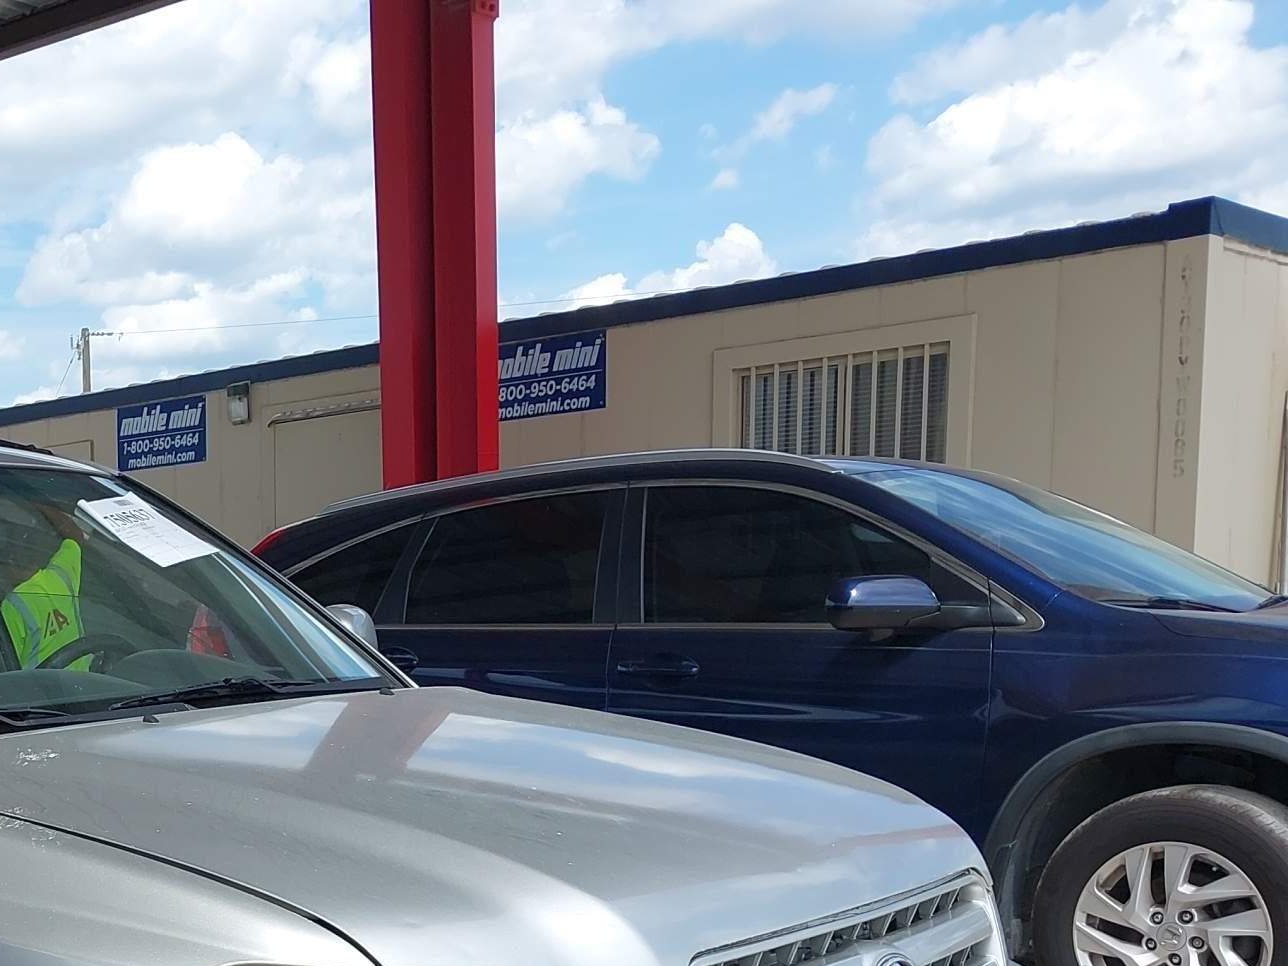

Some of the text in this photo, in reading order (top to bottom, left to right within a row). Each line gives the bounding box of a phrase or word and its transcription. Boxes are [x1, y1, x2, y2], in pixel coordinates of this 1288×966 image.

[498, 339, 602, 380] obile mini
[498, 374, 596, 402] 800-950-6464
[120, 402, 204, 436] mobile mini
[124, 432, 199, 455] 1-800-950-6464
[128, 451, 195, 468] mobilemini.com
